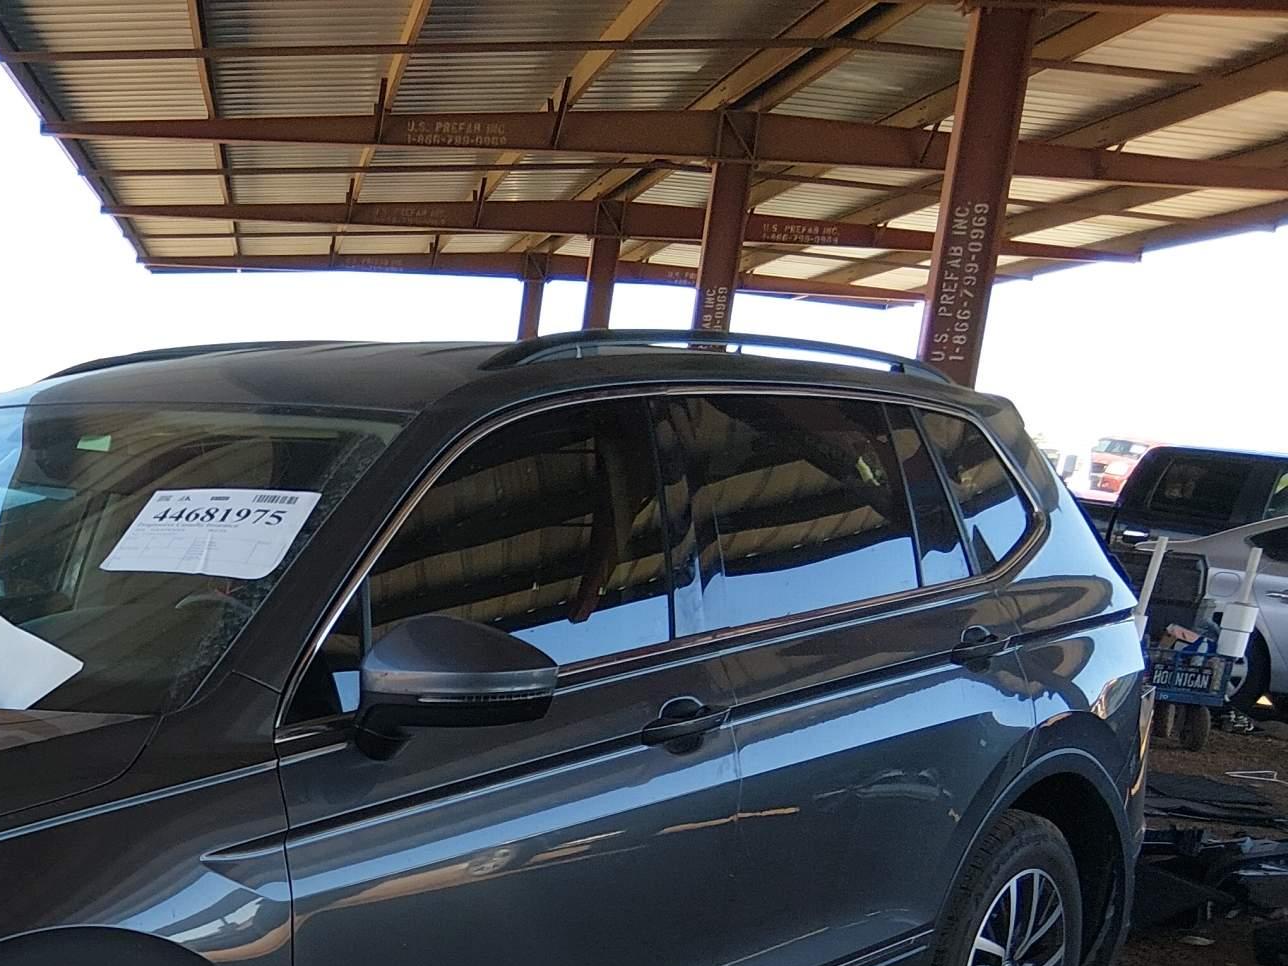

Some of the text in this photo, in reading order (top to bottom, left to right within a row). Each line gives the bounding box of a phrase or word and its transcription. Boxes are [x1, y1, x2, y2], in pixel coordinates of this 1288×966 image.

[929, 201, 972, 362] U.S. PREFAB INC.
[948, 202, 991, 362] 1-866-799-0969
[153, 507, 288, 526] 44681975
